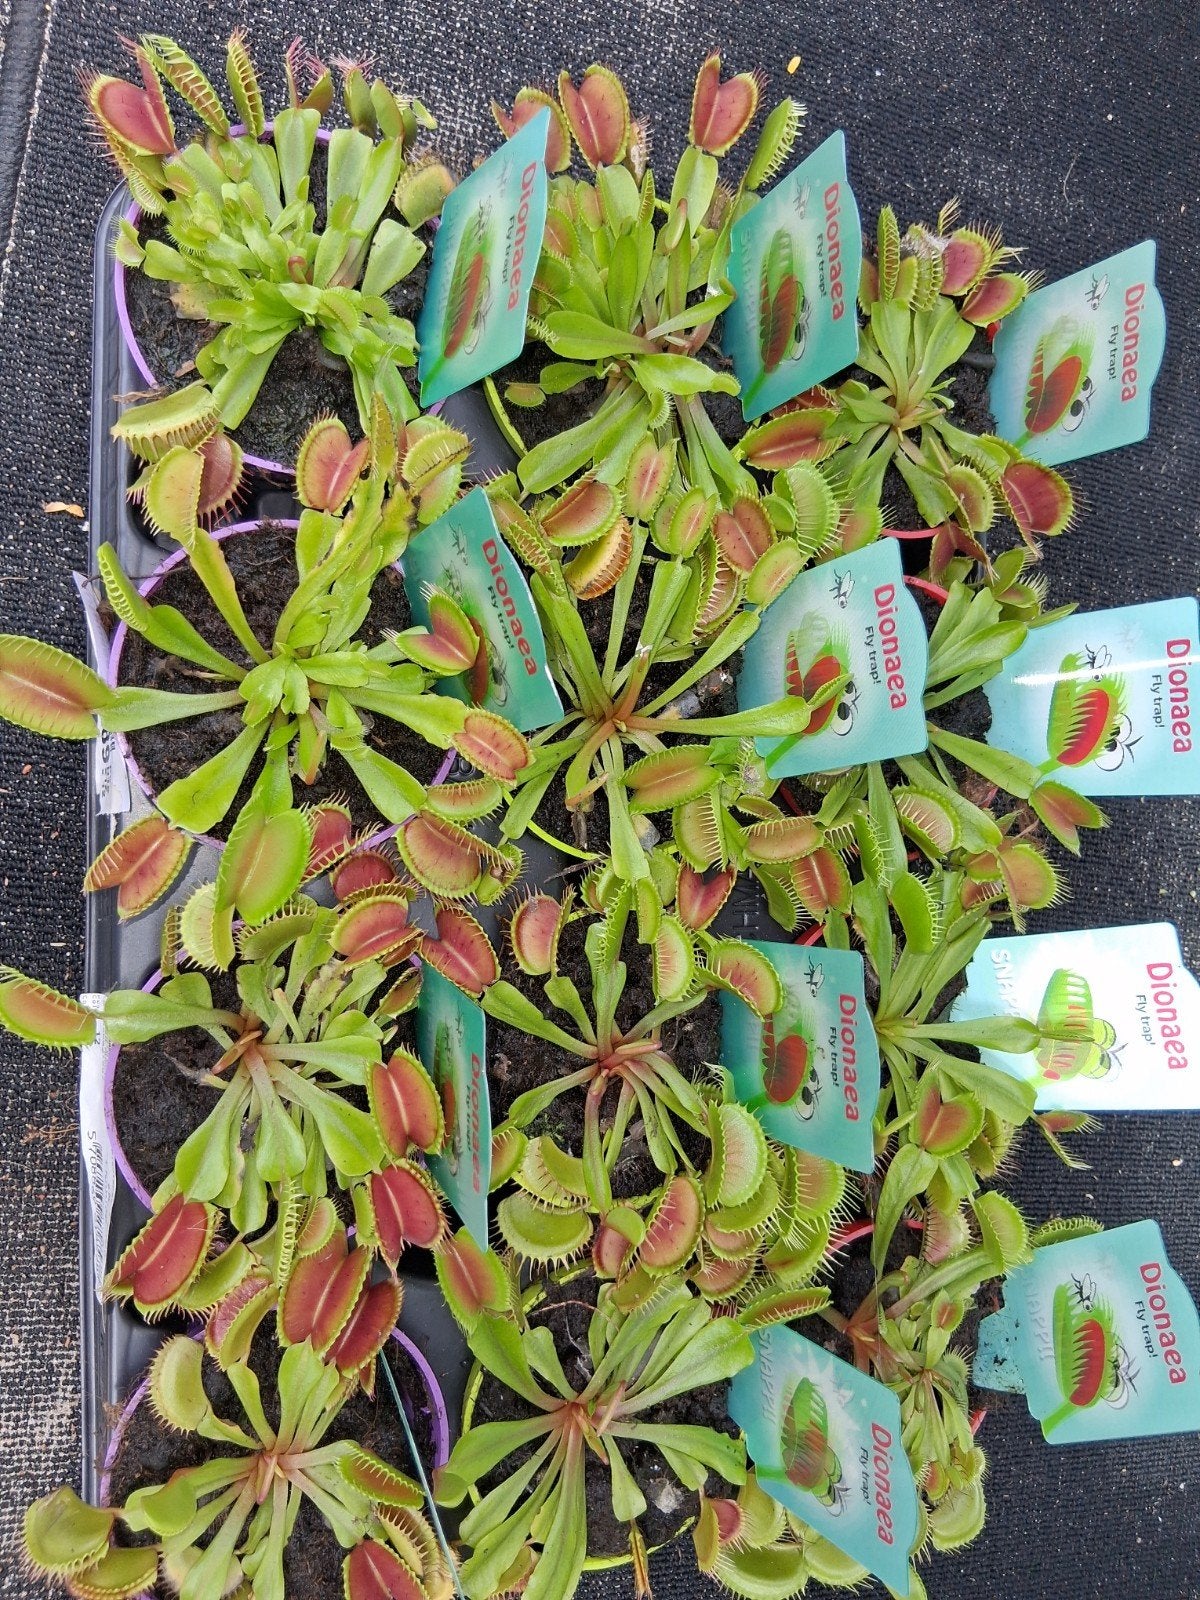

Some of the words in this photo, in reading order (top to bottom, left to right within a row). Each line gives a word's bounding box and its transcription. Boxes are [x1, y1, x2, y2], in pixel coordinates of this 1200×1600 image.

[507, 161, 537, 311] Dionaea
[824, 182, 845, 320] Dionaea
[1108, 324, 1119, 345] Fly
[1121, 283, 1145, 402] Dionaea
[1106, 347, 1118, 381] trap!
[482, 538, 537, 677] Dionaea
[864, 626, 875, 647] Fly
[873, 582, 910, 711] Dionaea
[868, 650, 881, 685] trap!
[1150, 674, 1163, 694] Fly
[1166, 638, 1192, 753] Dionaea
[1153, 697, 1165, 728] trap!
[1135, 995, 1147, 1013] Fly
[1146, 962, 1188, 1070] Dionaea
[828, 1026, 837, 1048] Fly
[839, 993, 859, 1122] Dionaea
[830, 1052, 840, 1088] trap!
[471, 1053, 481, 1193] Dionaea
[1134, 1301, 1146, 1321] Fly
[1141, 1324, 1158, 1358] trap!
[1139, 1262, 1187, 1384] Dionaea
[859, 1446, 868, 1469] Fly
[871, 1422, 894, 1545] Dionaea
[861, 1471, 872, 1505] trap!
